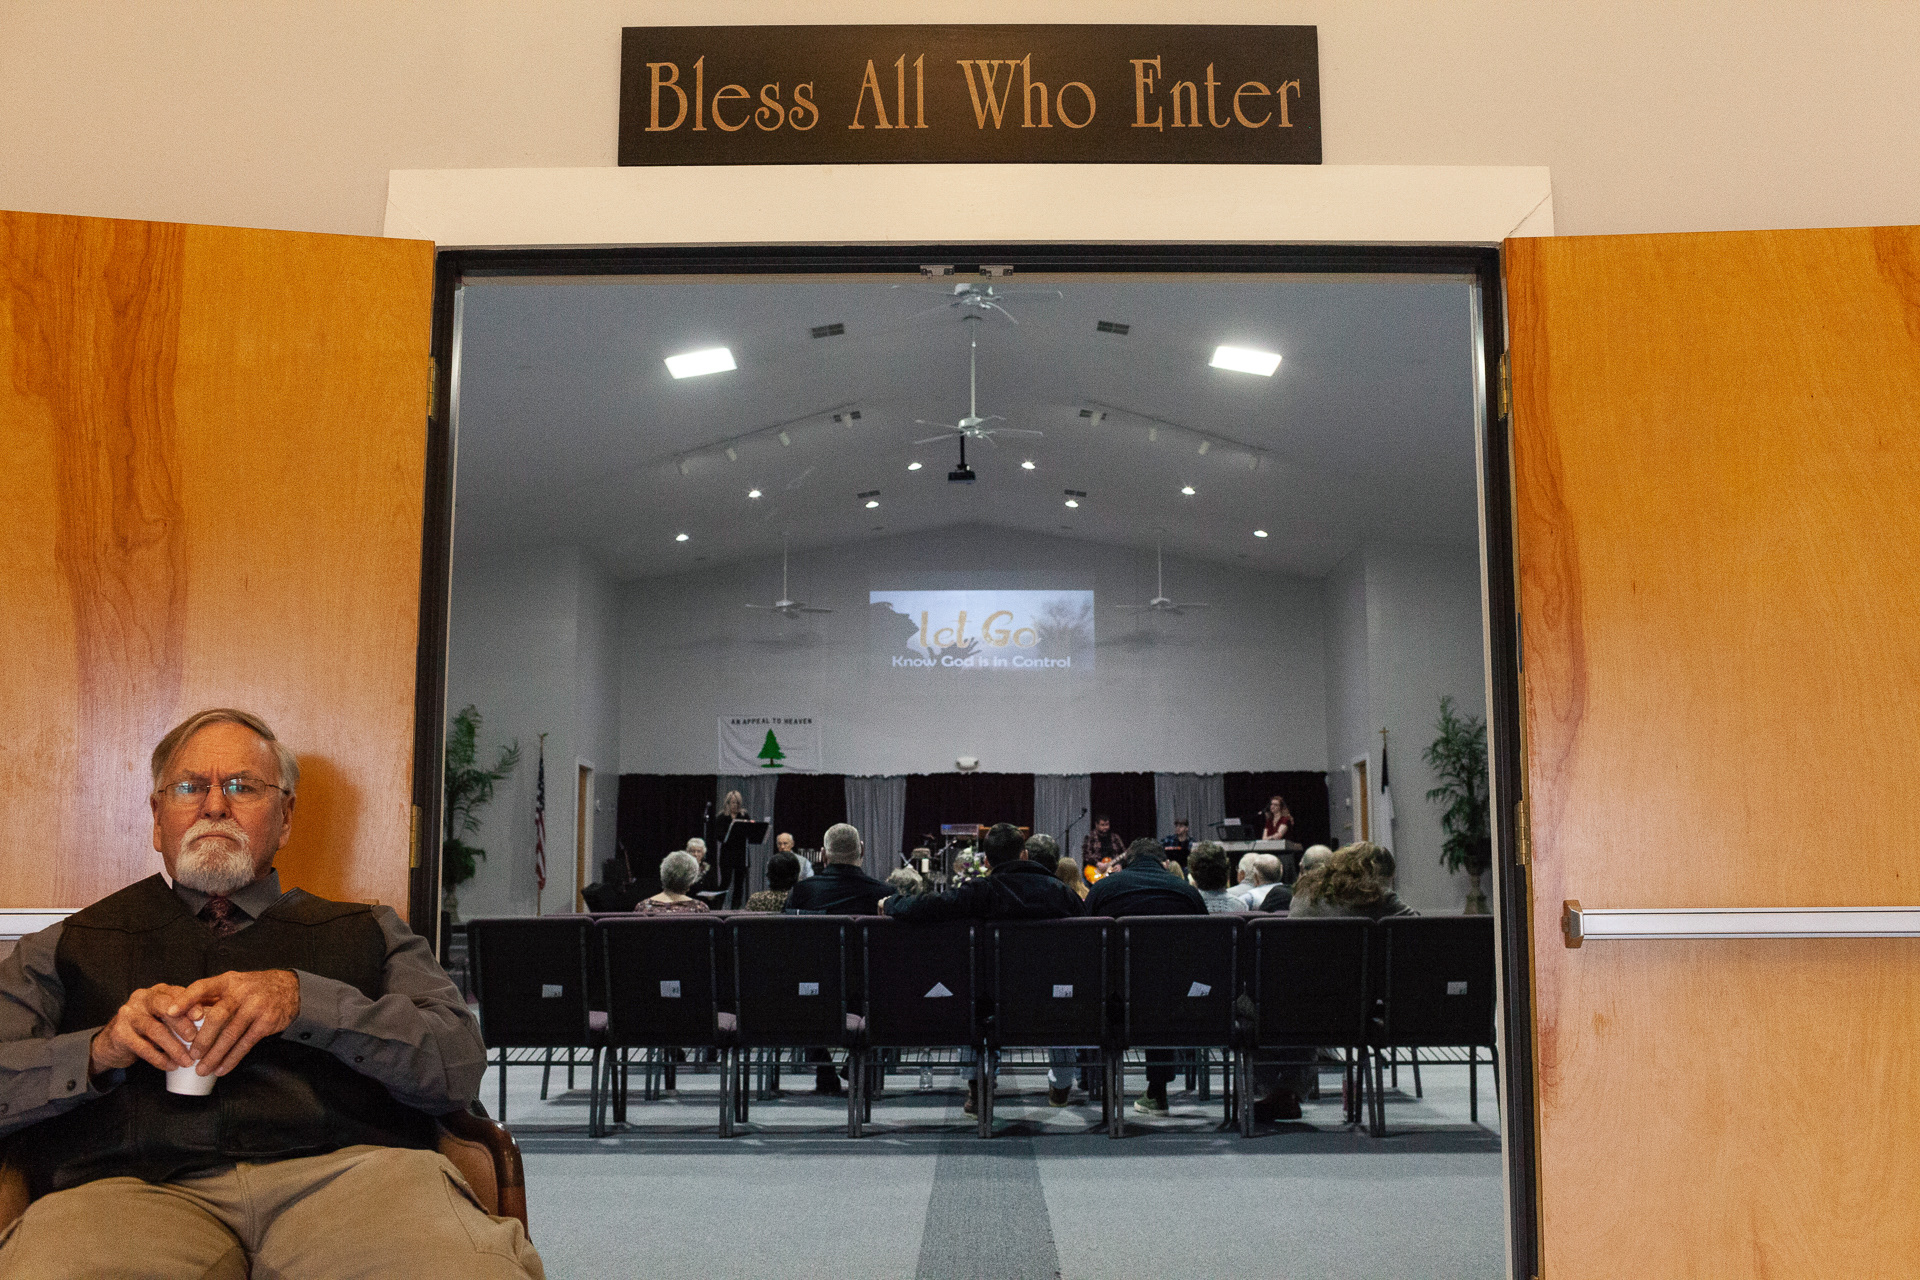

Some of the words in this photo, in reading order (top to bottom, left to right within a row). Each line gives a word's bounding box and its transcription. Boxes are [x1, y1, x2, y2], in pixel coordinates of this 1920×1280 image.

[645, 55, 819, 133] Bless
[848, 52, 929, 130] All
[956, 52, 1097, 131] Who
[1129, 55, 1301, 132] Enter
[982, 610, 1041, 648] Go
[892, 655, 937, 668] Know
[941, 655, 974, 668] God
[979, 655, 989, 668] is
[993, 655, 1007, 668] in
[1012, 655, 1071, 668] Control
